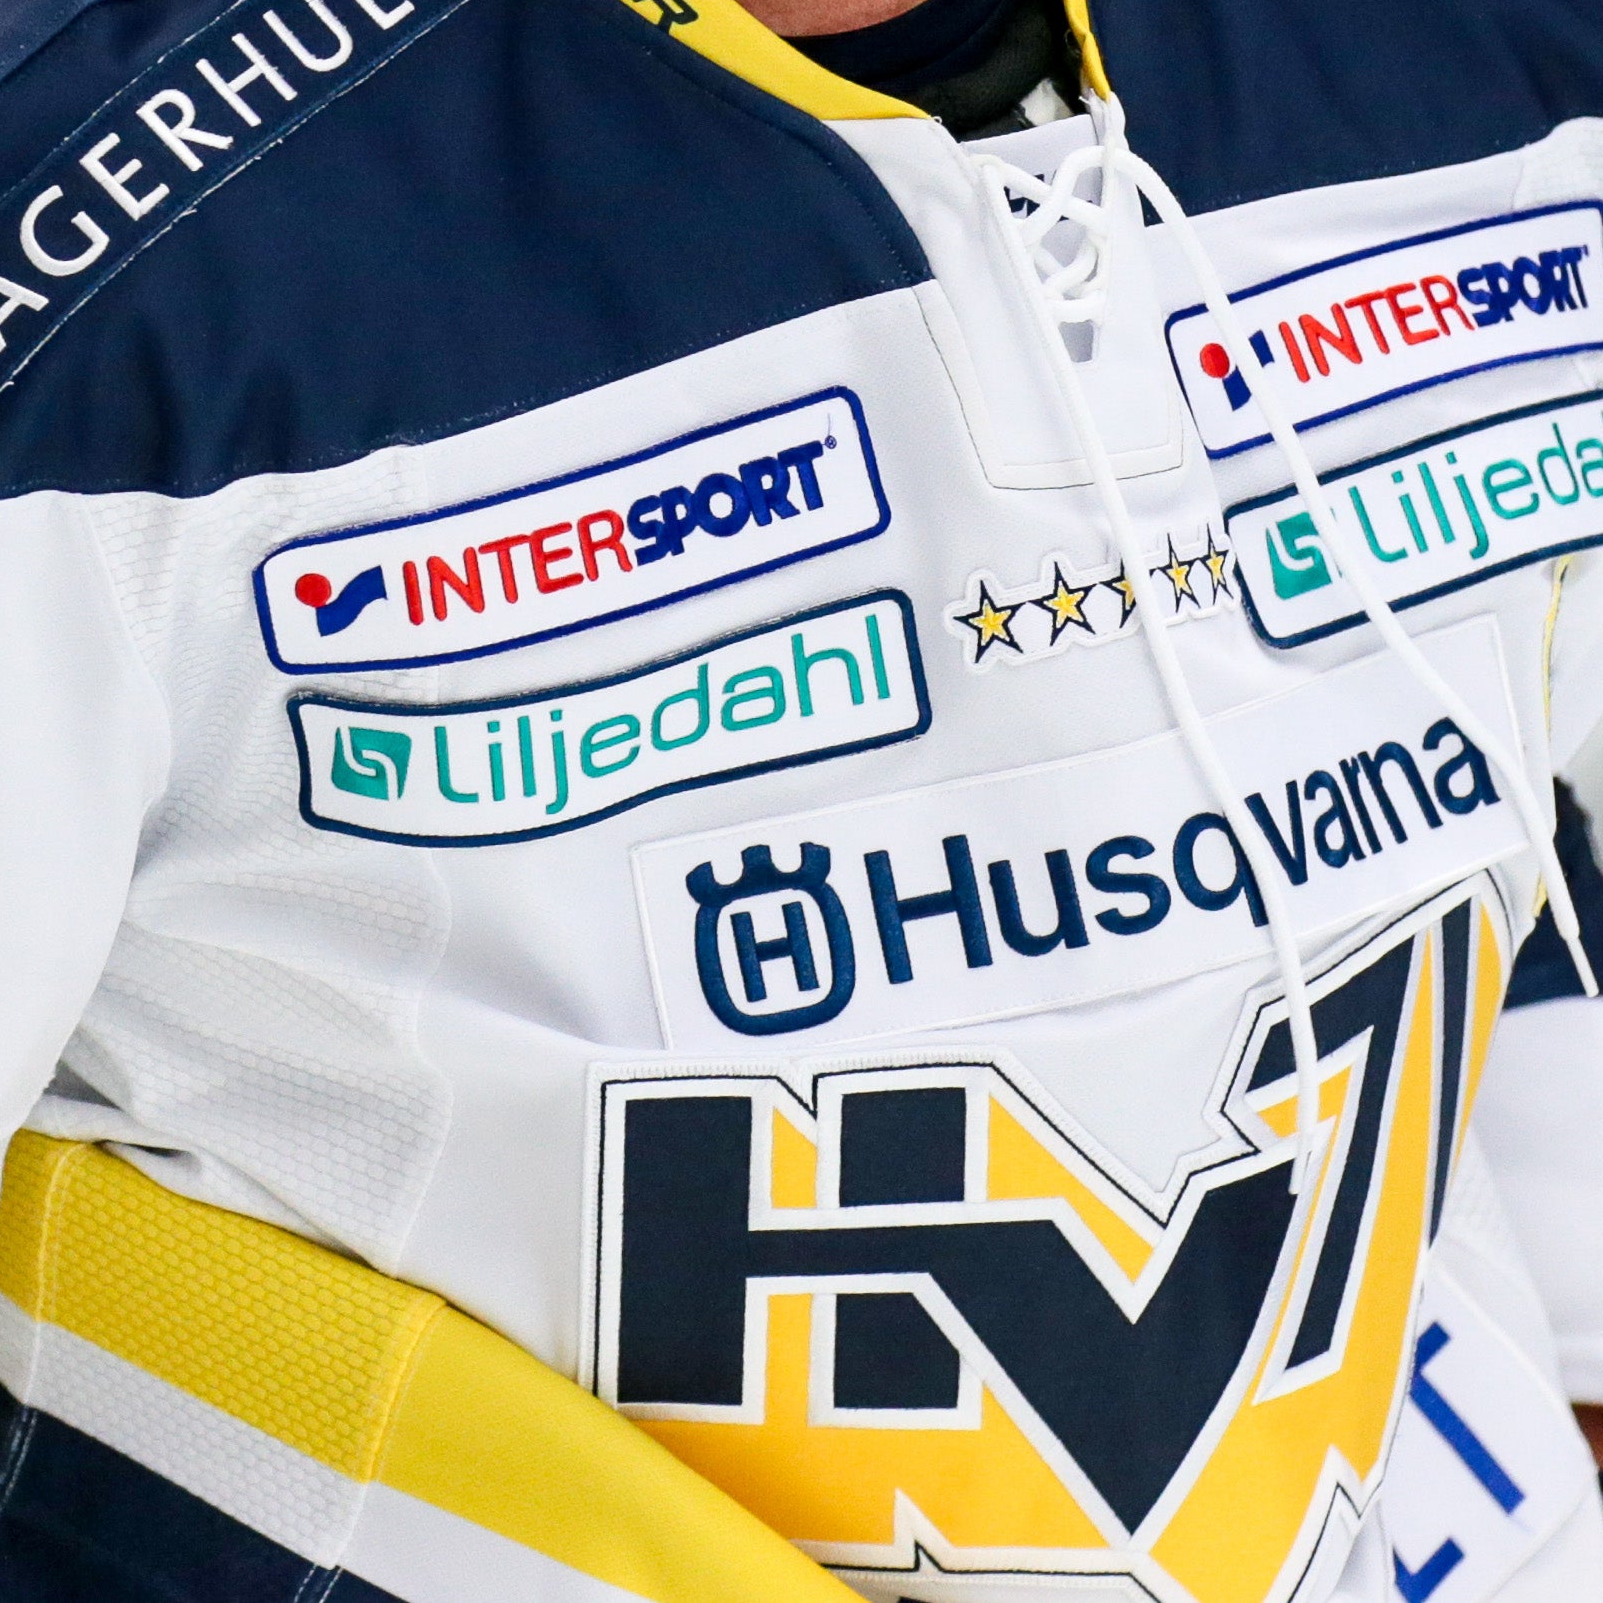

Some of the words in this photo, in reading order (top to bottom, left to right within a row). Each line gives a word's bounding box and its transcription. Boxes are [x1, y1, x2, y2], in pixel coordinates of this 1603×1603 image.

[1278, 246, 1590, 384] INTERSPORT
[402, 438, 830, 629] INTERSPORT
[432, 615, 896, 816] Liljedahl
[863, 712, 1502, 986] Husqvarna
